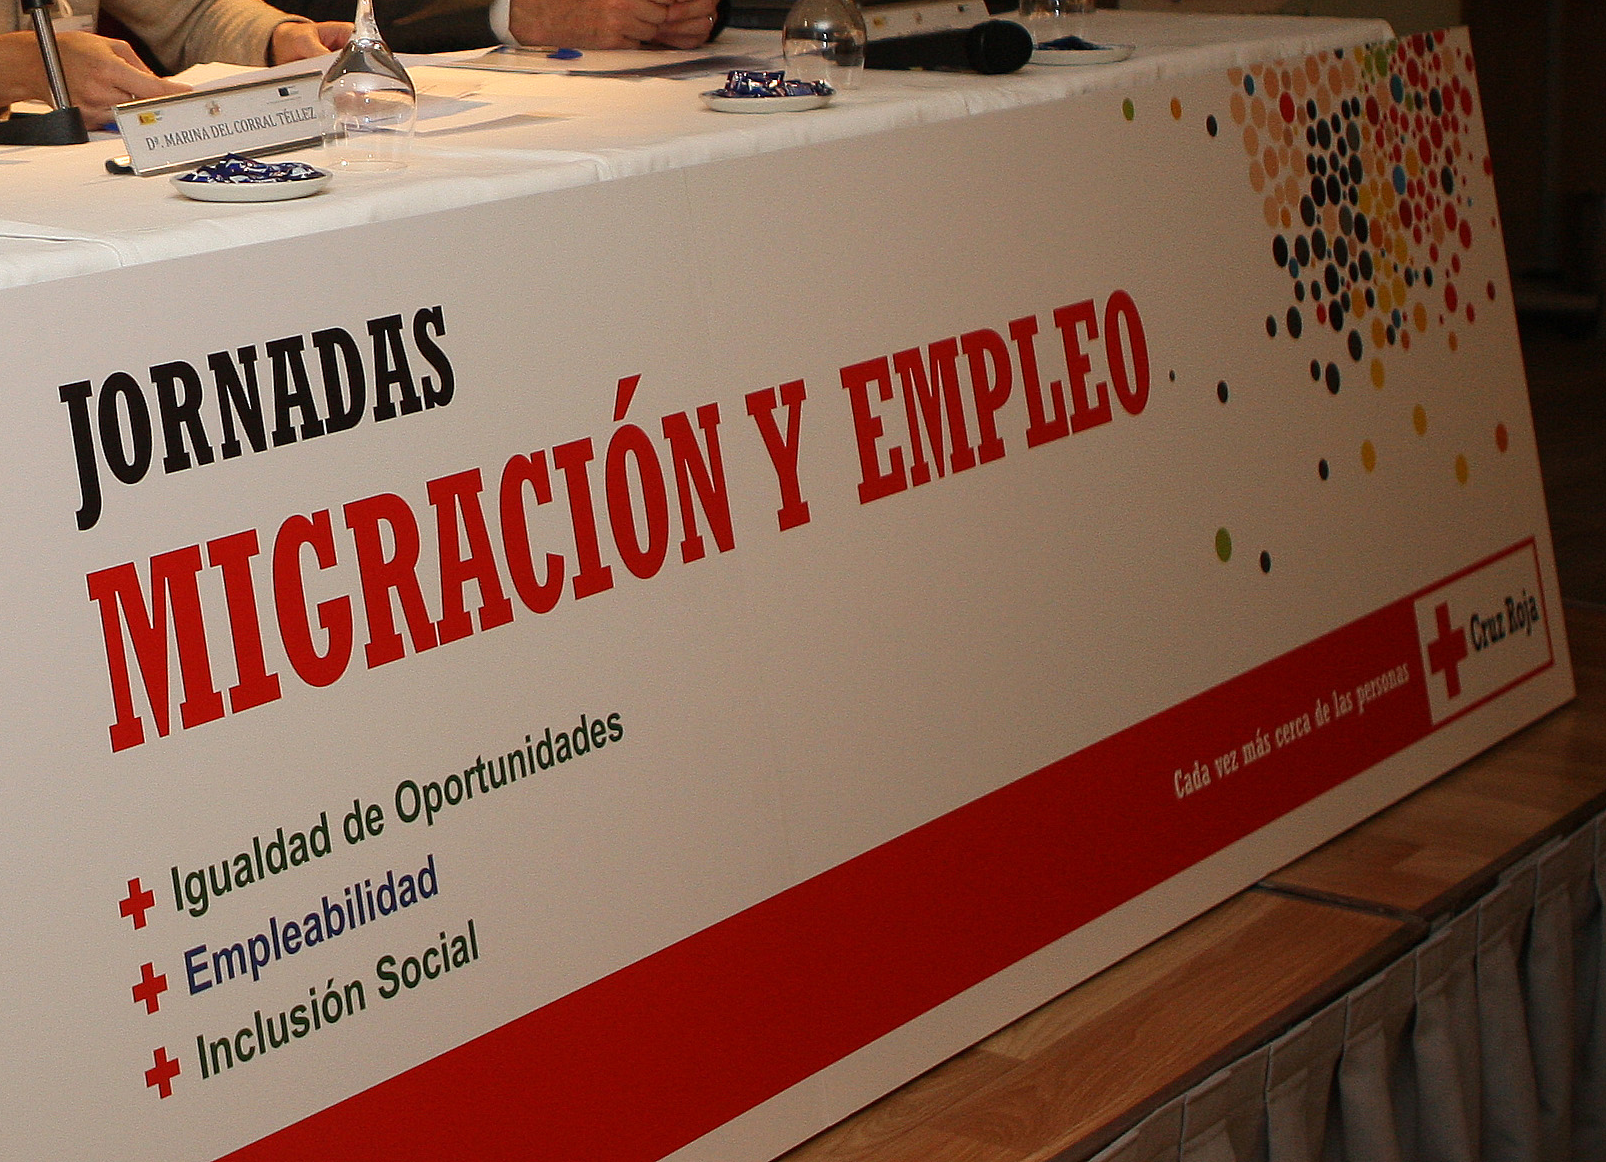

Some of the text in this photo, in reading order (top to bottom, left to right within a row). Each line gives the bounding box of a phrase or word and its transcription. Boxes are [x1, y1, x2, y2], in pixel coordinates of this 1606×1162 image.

[164, 127, 210, 148] MARINA
[210, 122, 233, 139] DEL
[234, 114, 277, 134] CORRAL
[277, 106, 317, 126] TÉLLEZ
[58, 305, 455, 531] JORNADAS
[85, 289, 1151, 754] MIGRACIÓN Y EMPLEO
[1471, 588, 1539, 651] Cruz Roja
[1174, 662, 1411, 800] Cada vez más cerca de las personas
[170, 712, 625, 918] Igualdad de Oportunidades
[184, 854, 440, 996] Empleabilidad
[197, 919, 480, 1079] Inclusión Social
